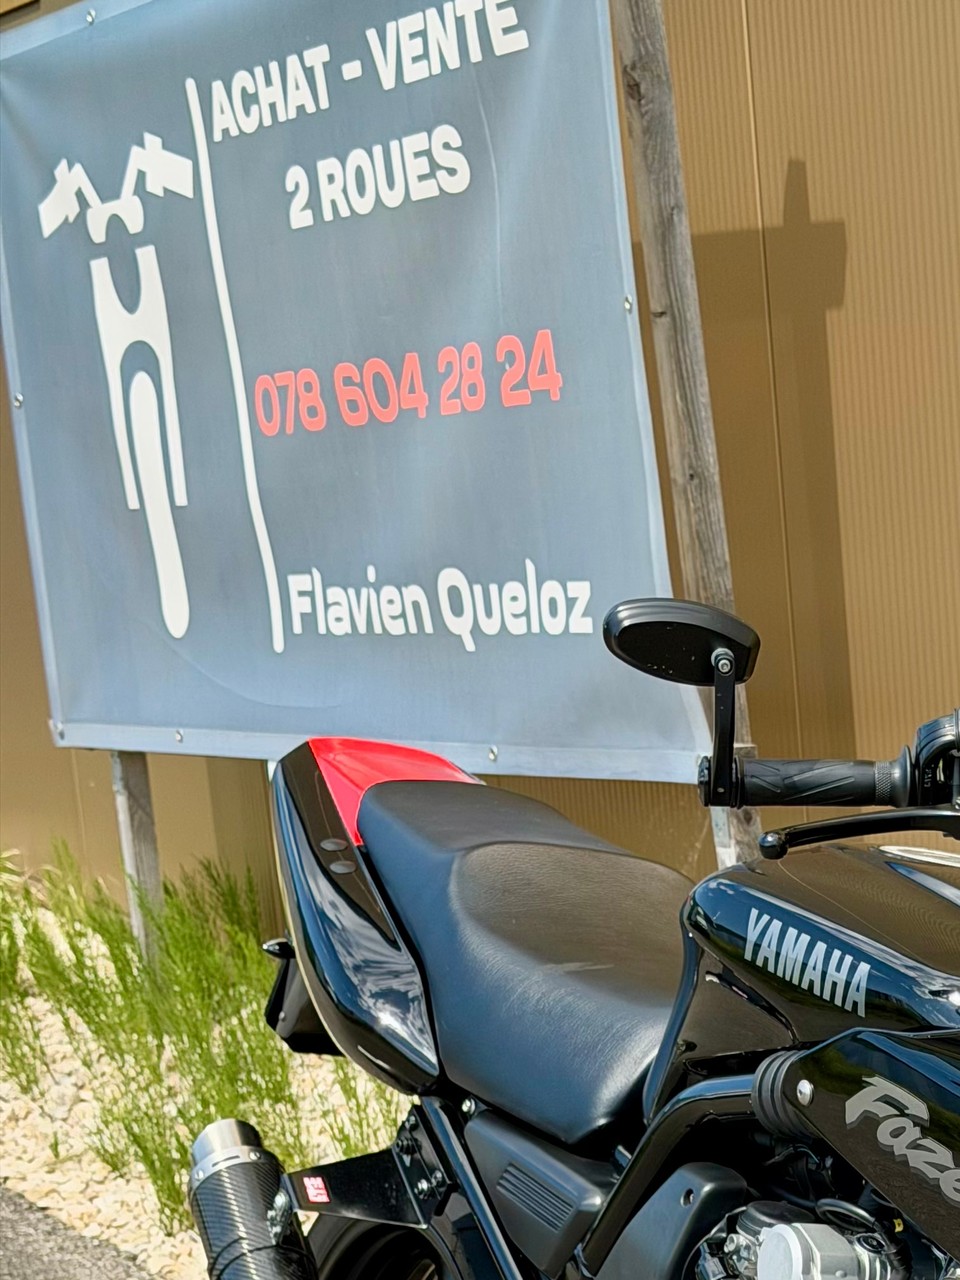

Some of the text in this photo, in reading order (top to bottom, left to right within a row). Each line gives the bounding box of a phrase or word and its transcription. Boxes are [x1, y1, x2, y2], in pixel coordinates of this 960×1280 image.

[211, 44, 331, 142] ACHAT
[365, 0, 529, 91] VENTE
[285, 124, 471, 230] 2 ROUES
[255, 330, 562, 436] 078 604 28 24
[287, 558, 593, 652] Flavien Queloz
[743, 907, 871, 1018] YAMAHA
